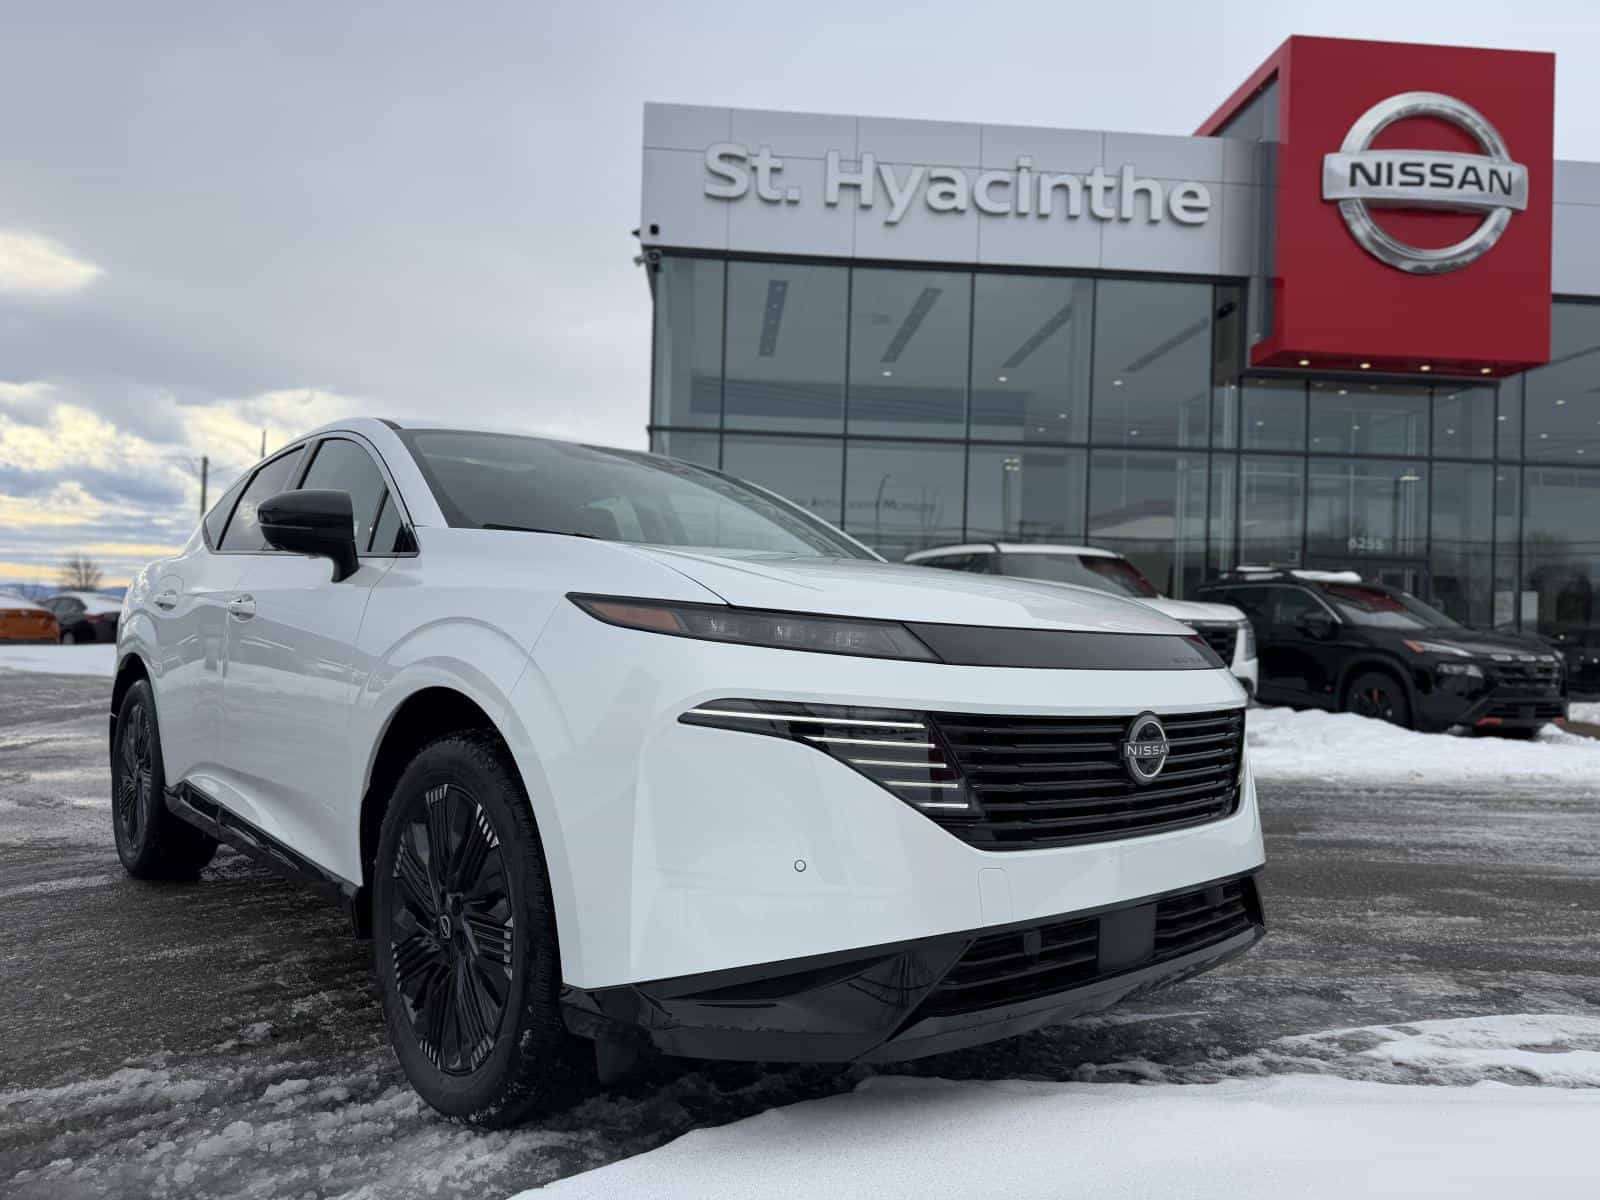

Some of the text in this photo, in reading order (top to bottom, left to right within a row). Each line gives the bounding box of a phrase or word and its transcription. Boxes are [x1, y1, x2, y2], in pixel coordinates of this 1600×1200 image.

[704, 142, 1211, 225] St. Hyacinthe
[1349, 161, 1512, 196] NISSAN
